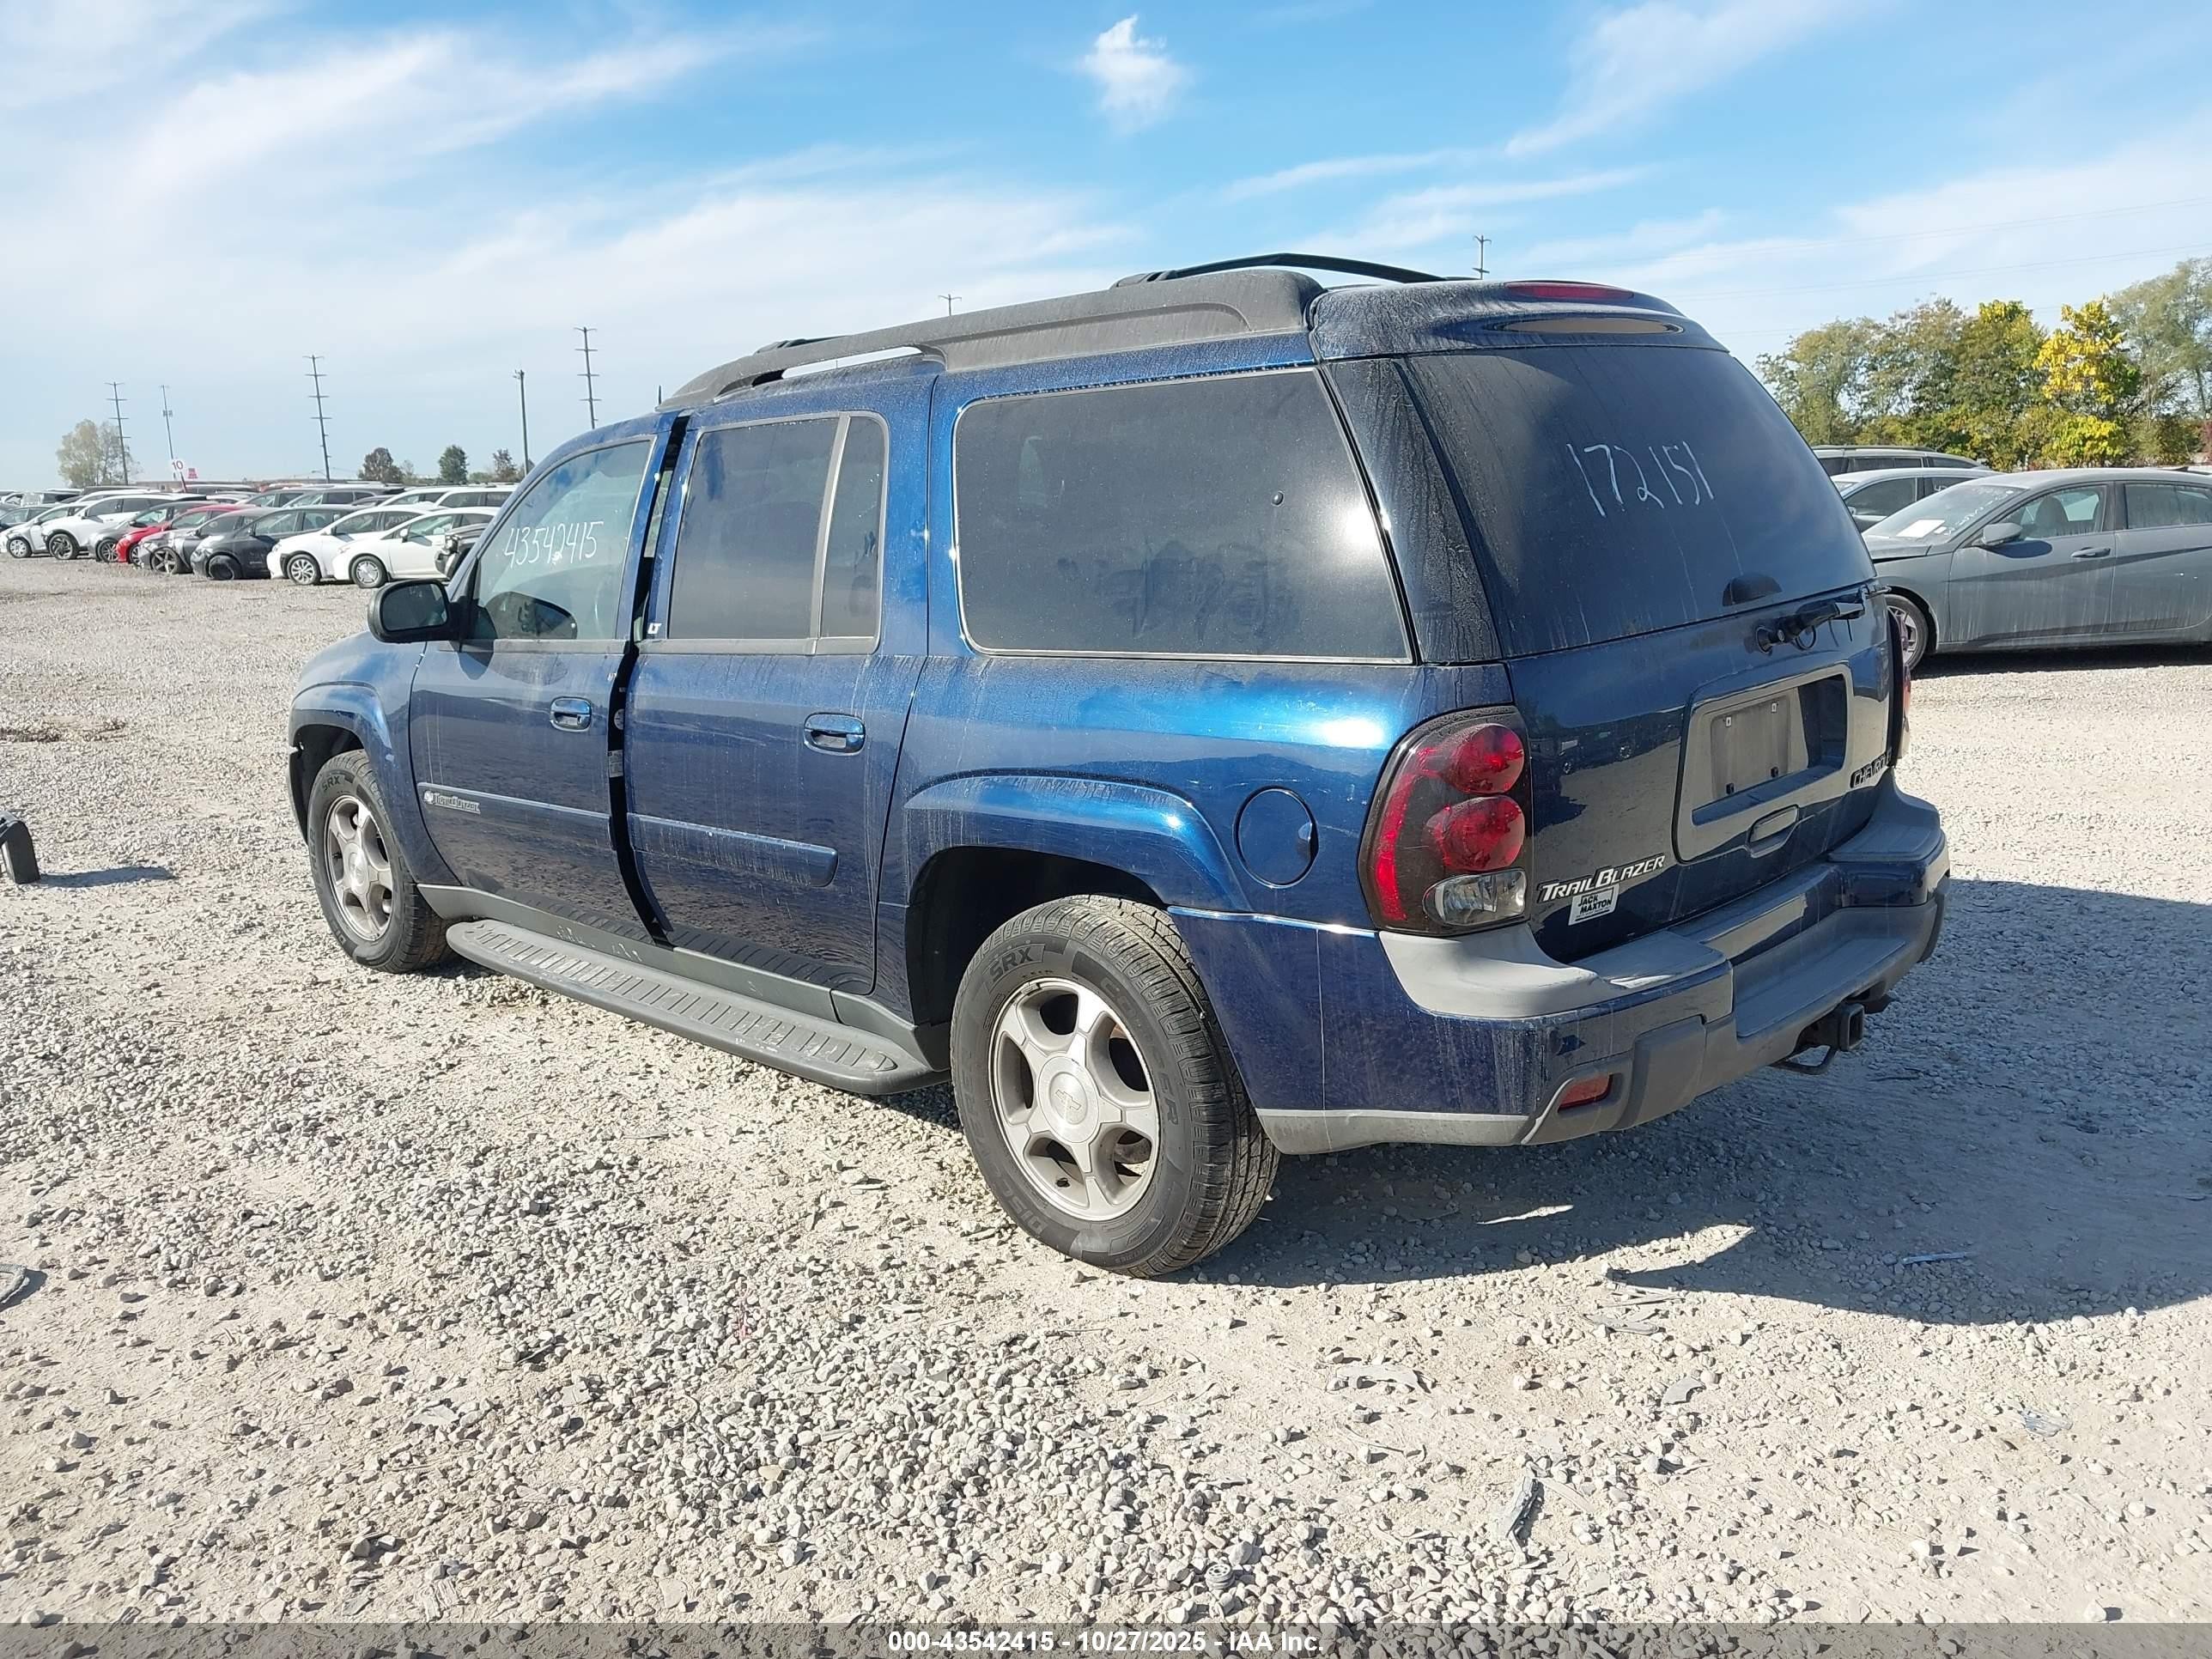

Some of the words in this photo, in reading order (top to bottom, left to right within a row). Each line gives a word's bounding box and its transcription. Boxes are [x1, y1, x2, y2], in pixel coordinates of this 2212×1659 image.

[172, 460, 184, 471] 10
[1566, 441, 1715, 518] 172151
[504, 520, 605, 569] 43542415
[647, 623, 662, 635] LT
[321, 775, 341, 793] SRX
[1578, 894, 1599, 907] JACK
[1580, 899, 1612, 915] MAXTON
[988, 949, 1034, 983] SRX
[1100, 976, 1179, 1125] COER
